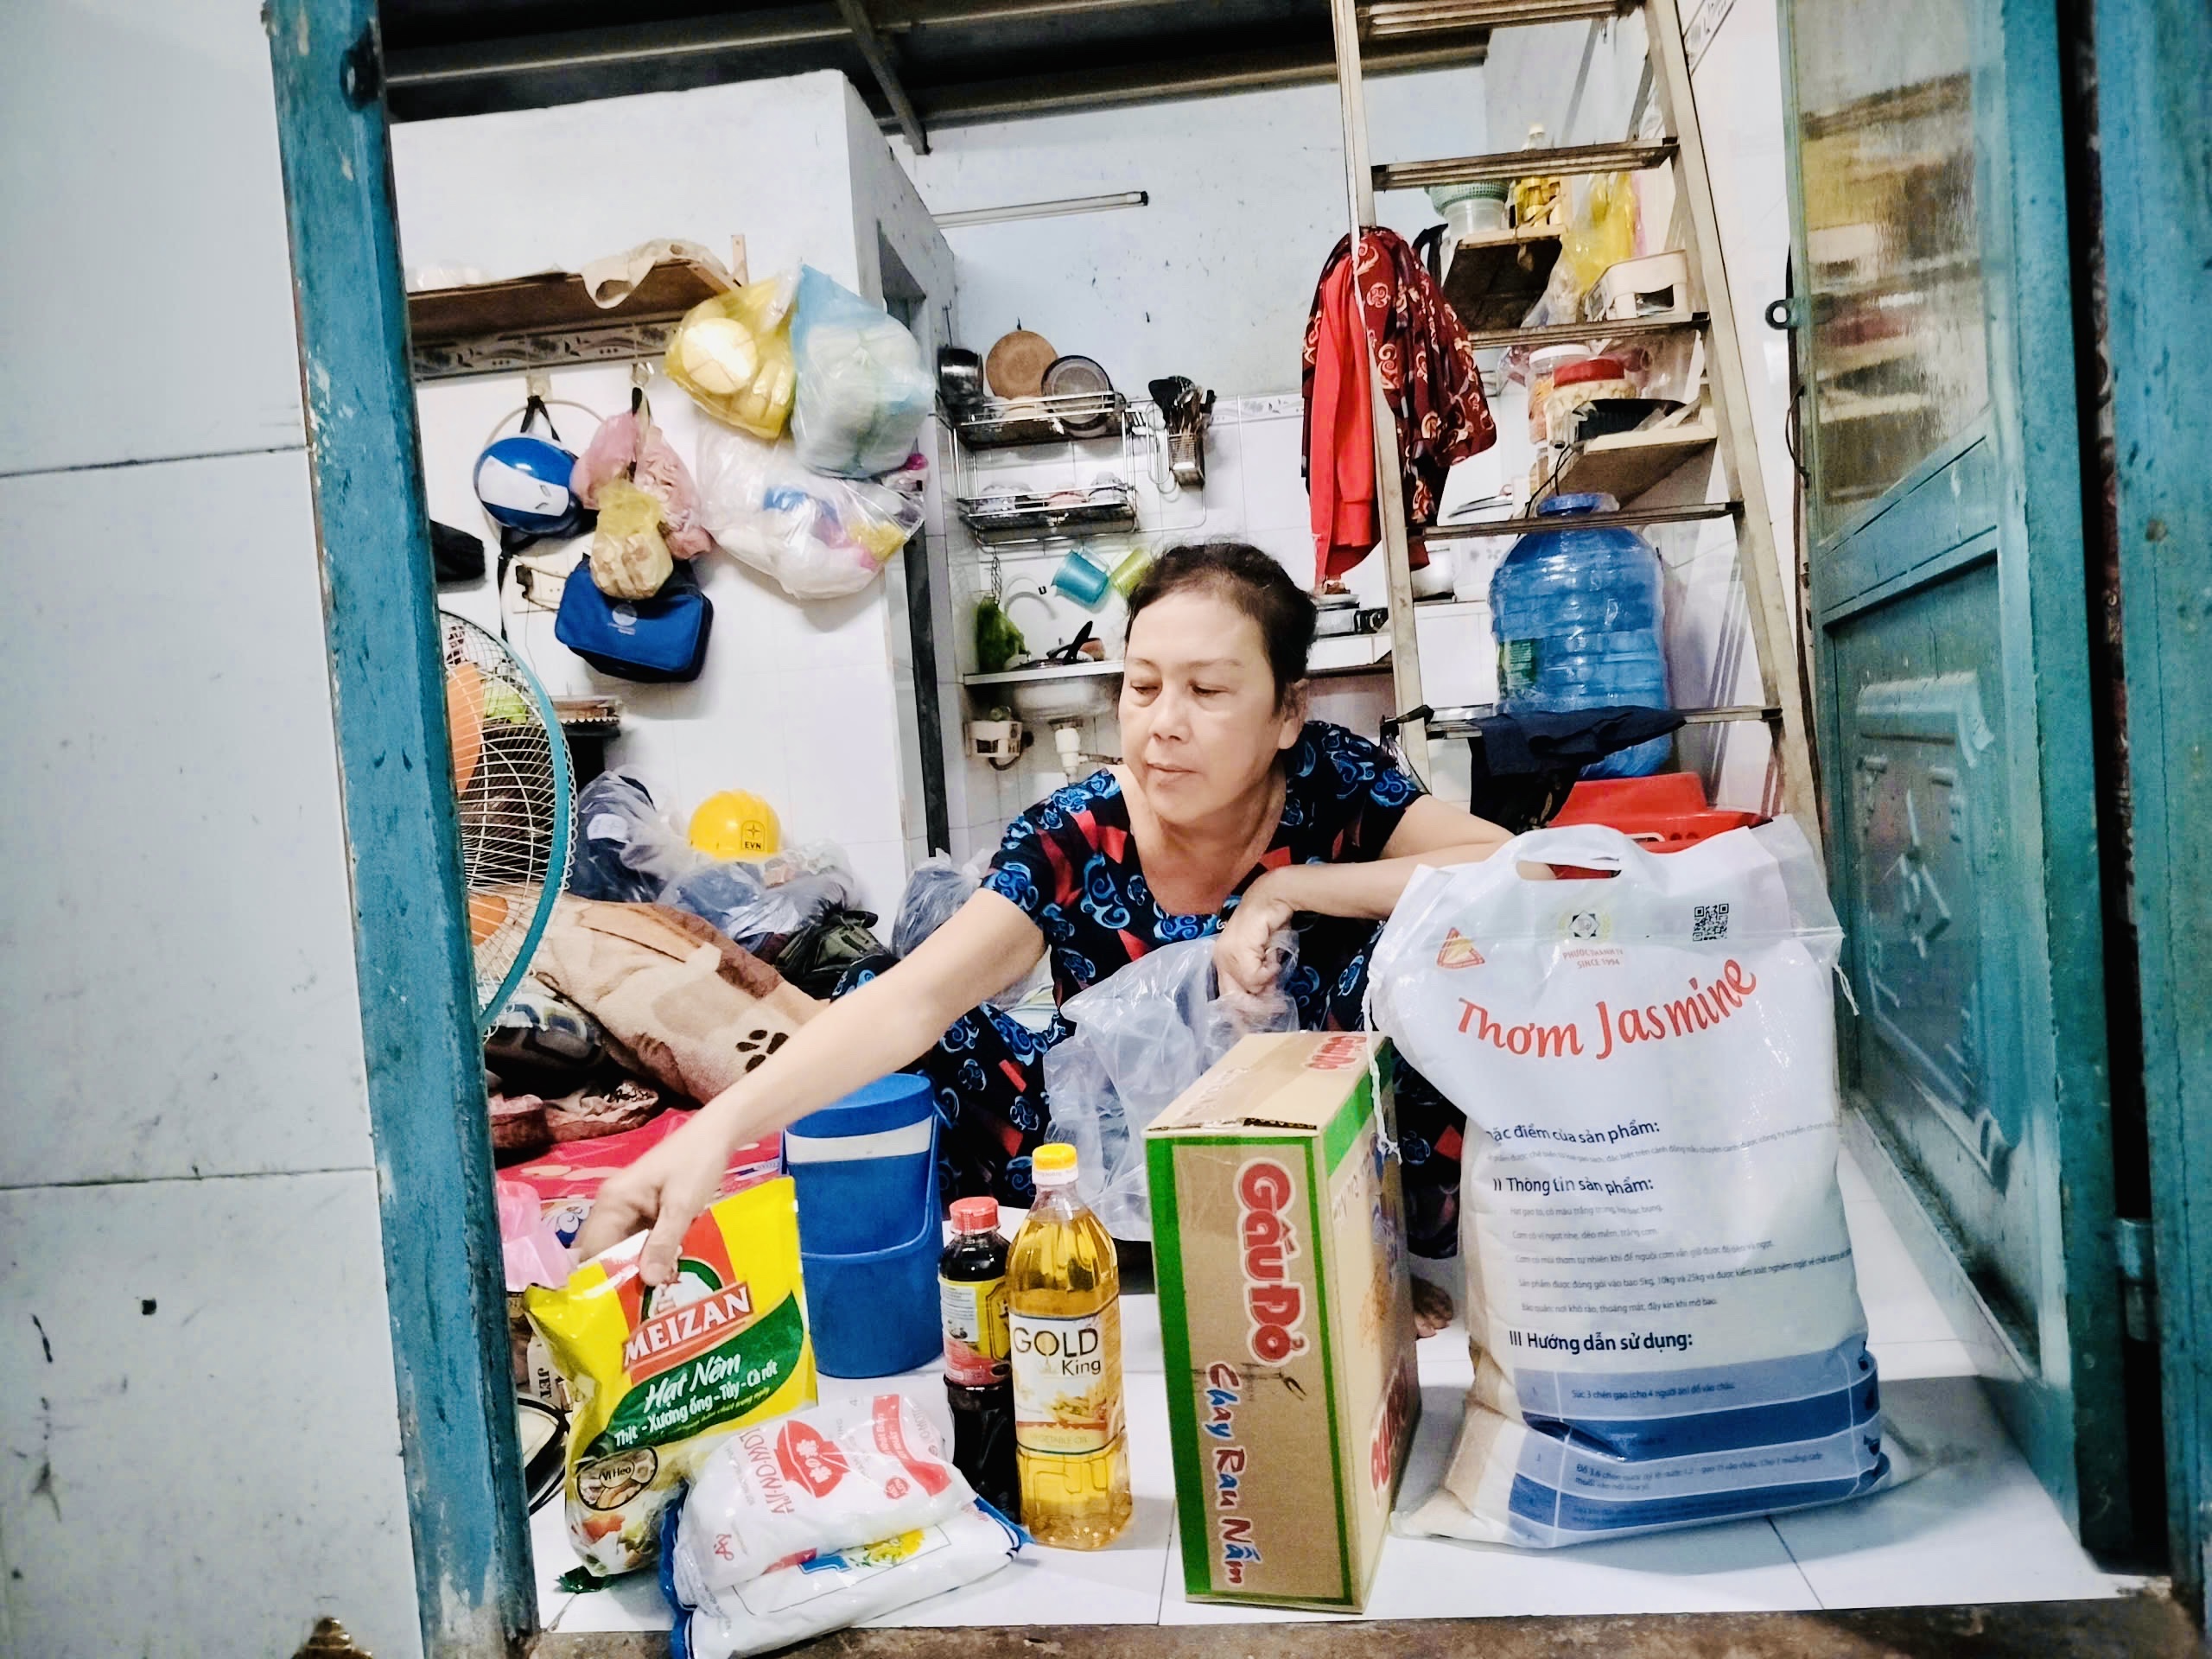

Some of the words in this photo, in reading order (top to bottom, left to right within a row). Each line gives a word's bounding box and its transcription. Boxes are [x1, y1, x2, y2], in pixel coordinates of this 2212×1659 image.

[745, 841, 761, 849] EVN
[1577, 959, 1600, 969] SINCE
[1458, 996, 1585, 1058] Thơm
[1595, 958, 1758, 1060] Jasmine
[1514, 1122, 1551, 1140] điểm
[1553, 1129, 1578, 1143] của
[1580, 1127, 1606, 1144] sản
[1607, 1119, 1661, 1145] phẩm:
[1506, 1176, 1550, 1197] Thông
[1553, 1175, 1576, 1192] tin
[1578, 1176, 1605, 1192] sản
[1605, 1176, 1654, 1196] phẩm:
[624, 1285, 750, 1367] MEIZAN
[1013, 1327, 1098, 1358] GOLD
[1510, 1331, 1522, 1346] III
[1527, 1332, 1580, 1355] Hướng
[1583, 1332, 1617, 1351] dẫn
[1620, 1332, 1641, 1350] sử
[1643, 1332, 1693, 1354] dụng:
[537, 1367, 552, 1399] JET
[643, 1378, 689, 1414] Hạt
[689, 1351, 741, 1393] Nêm
[1062, 1359, 1101, 1376] King
[1205, 1363, 1242, 1439] Chay
[614, 1427, 639, 1449] Thịt
[1213, 1447, 1249, 1510] Rau
[1218, 1517, 1262, 1586] Nấm
